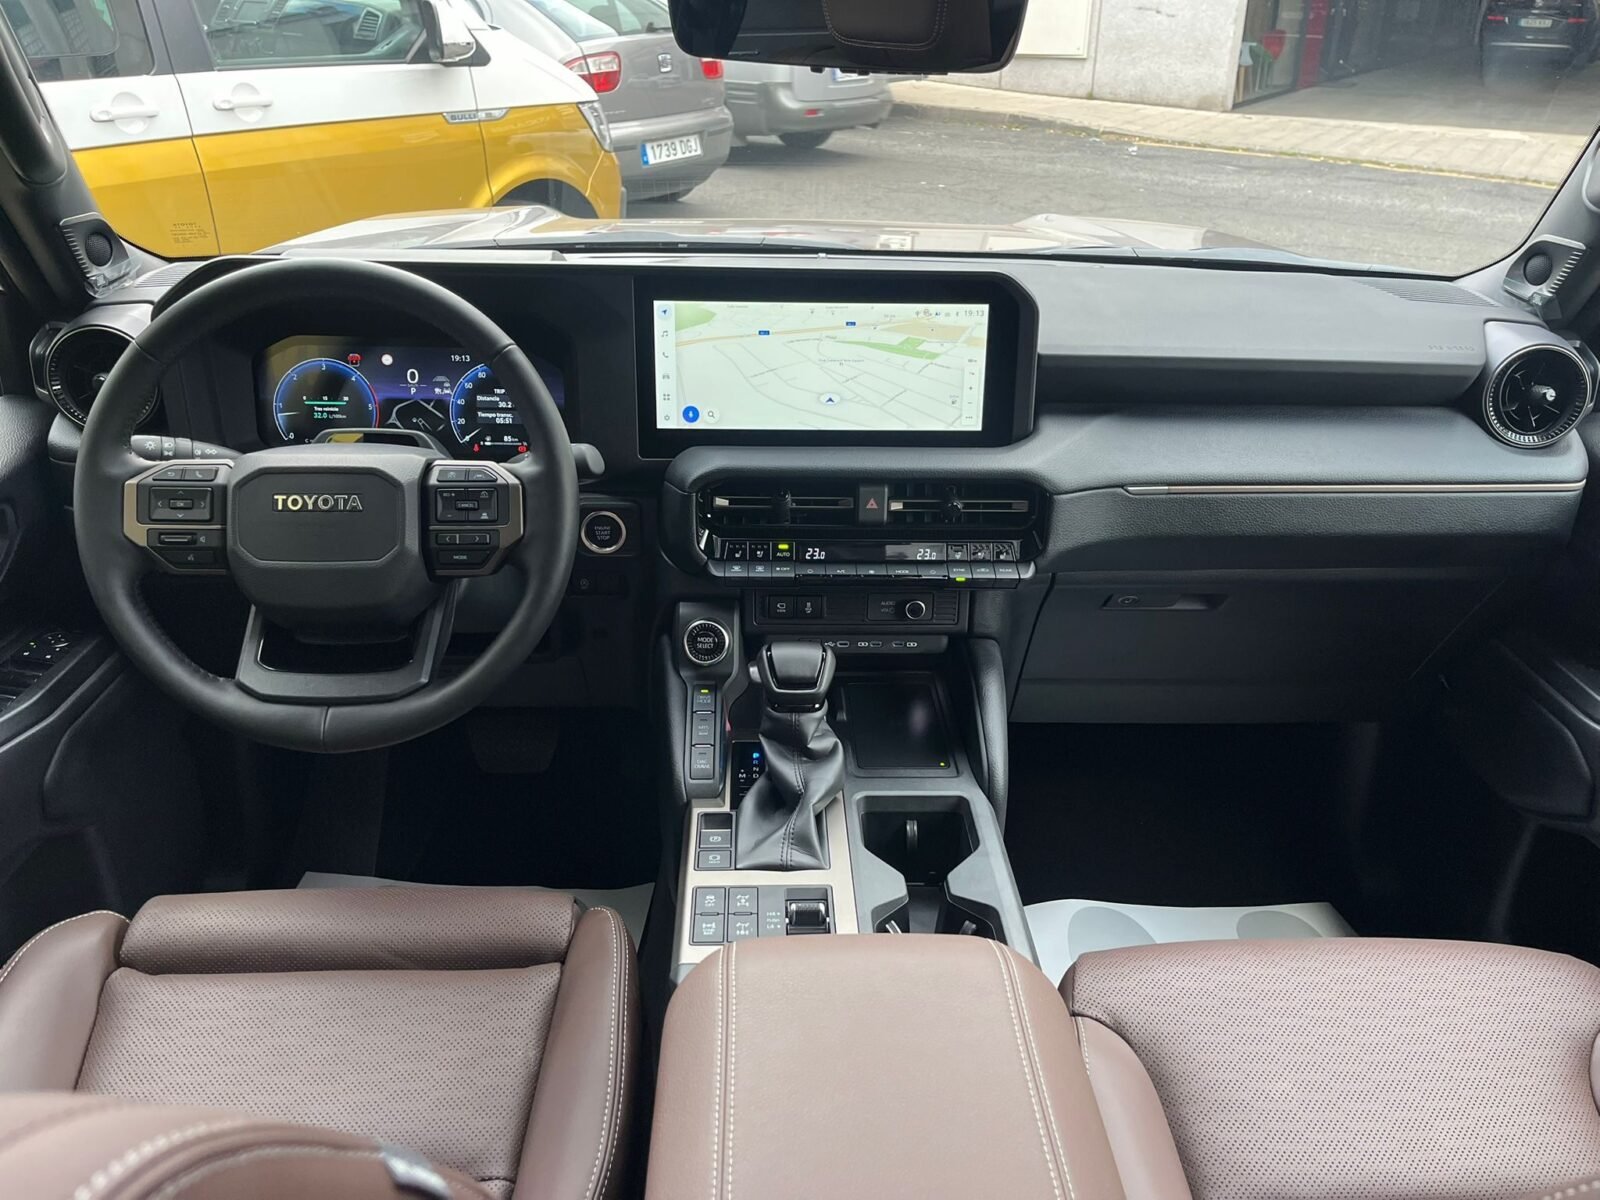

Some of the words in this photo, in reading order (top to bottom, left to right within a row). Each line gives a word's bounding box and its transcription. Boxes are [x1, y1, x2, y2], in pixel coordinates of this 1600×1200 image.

[450, 113, 477, 121] BULLI
[651, 142, 677, 160] 1739
[680, 138, 698, 154] DGJ
[964, 309, 985, 317] 19:13
[406, 368, 419, 384] 0
[410, 387, 416, 395] P
[273, 494, 363, 510] TOYOTA
[805, 548, 826, 559] 23.0
[916, 548, 937, 560] 23.0
